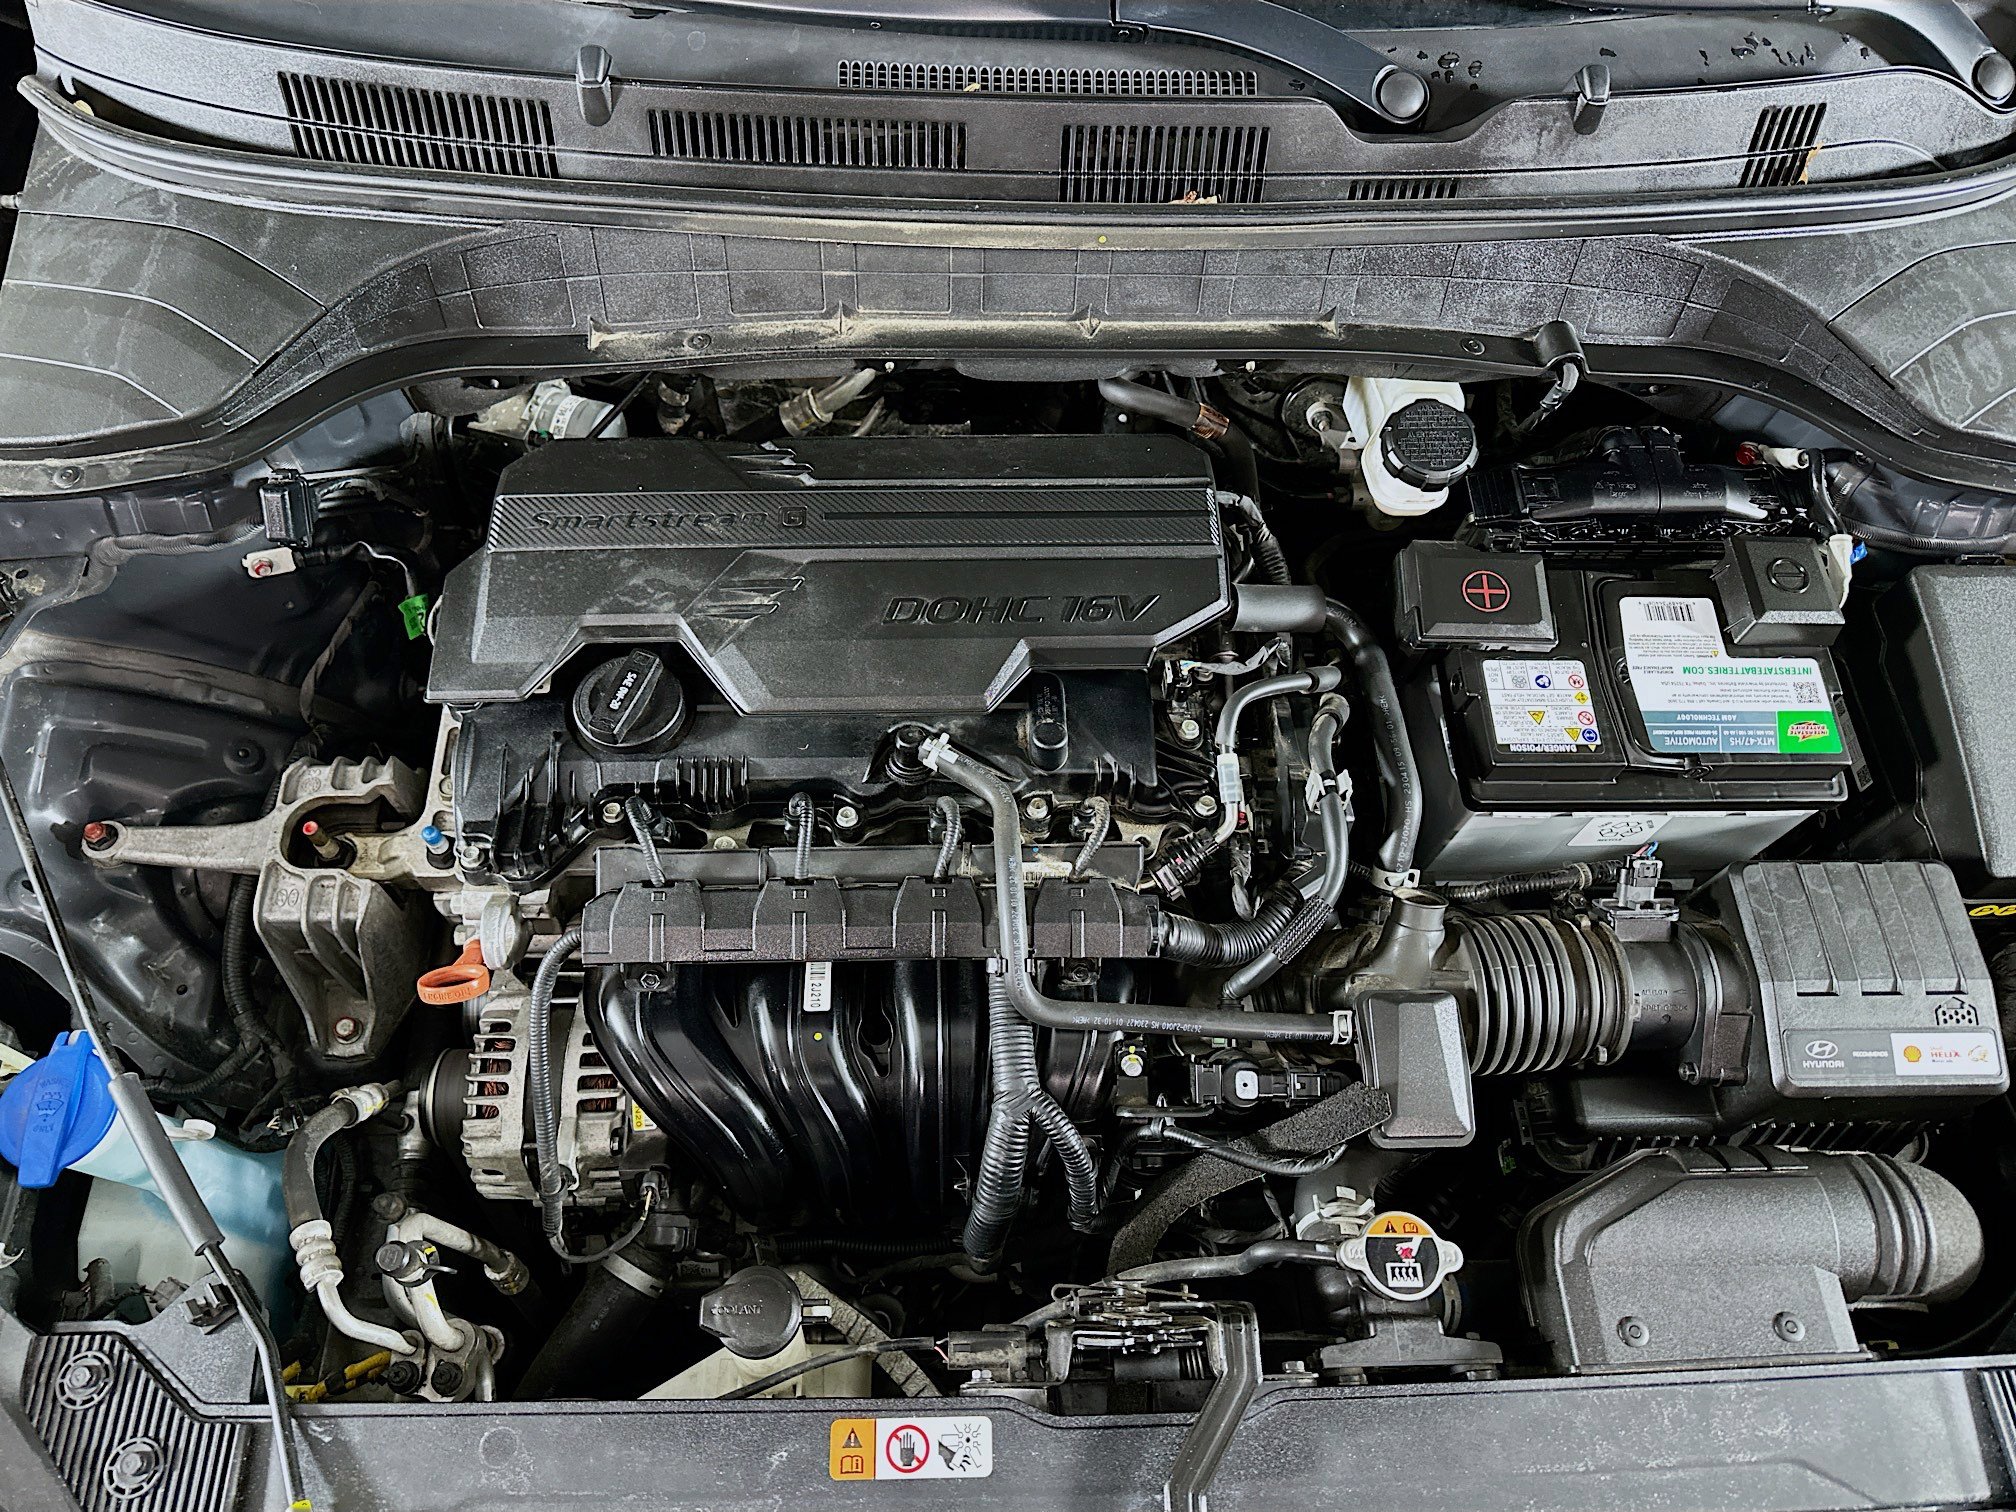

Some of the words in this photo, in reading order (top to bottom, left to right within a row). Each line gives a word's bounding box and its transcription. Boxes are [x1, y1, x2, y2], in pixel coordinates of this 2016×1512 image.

[525, 509, 768, 531] Smartstream
[881, 596, 1051, 625] DOHC
[1061, 594, 1161, 623] 16V
[1682, 666, 1812, 674] INTERSTATEBATTERIES.COM
[622, 671, 637, 688] SAE
[1664, 736, 1718, 746] AUTOMOTIVE
[1729, 737, 1774, 746] MTX-47/H5
[1510, 744, 1577, 752] DANGER/POISON
[1399, 761, 1411, 795] 230415
[1405, 800, 1412, 813] HS
[1151, 1020, 1160, 1028] HS
[1802, 1060, 1844, 1068] HYUNDAI
[710, 1304, 762, 1316] COOLANT
